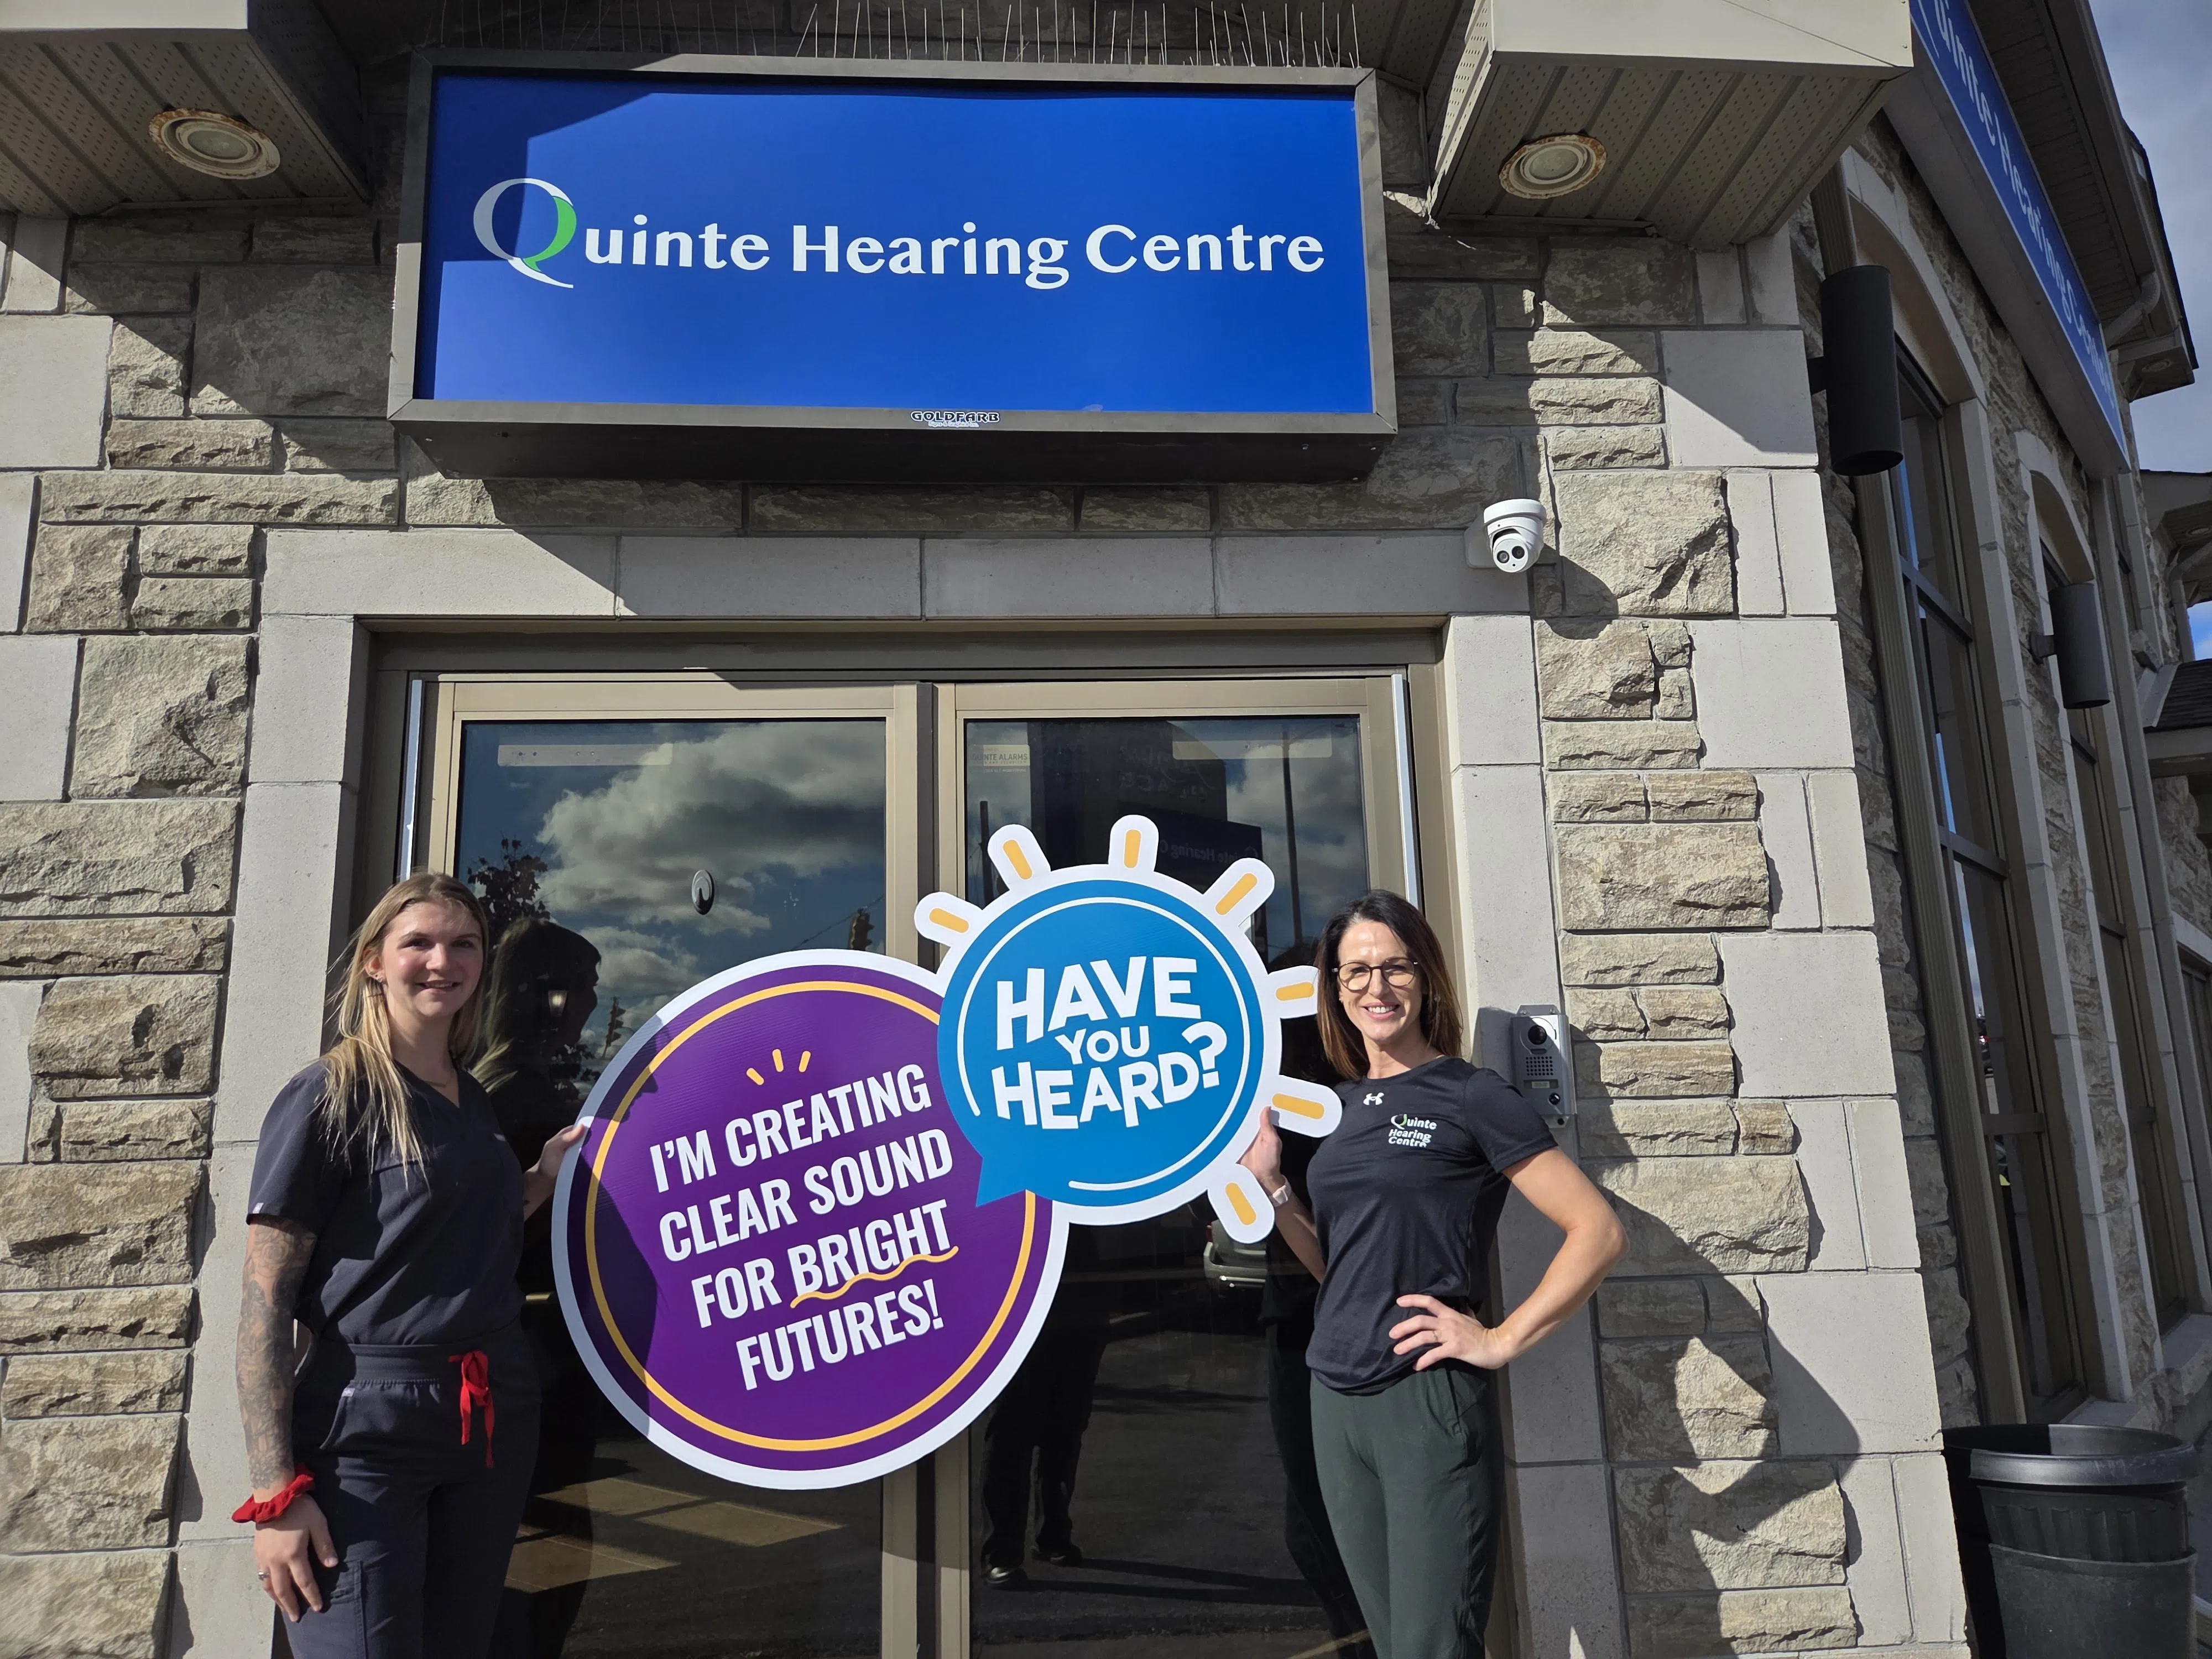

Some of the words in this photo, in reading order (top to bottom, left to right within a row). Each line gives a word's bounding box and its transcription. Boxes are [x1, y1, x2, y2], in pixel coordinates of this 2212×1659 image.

[1918, 0, 1995, 146] uinte
[1994, 112, 2066, 324] Hearing
[473, 178, 770, 289] Quinte
[793, 222, 1070, 290] Hearing
[1086, 225, 1325, 273] Centre
[911, 411, 1000, 423] GOLDFARB
[997, 956, 1201, 1051] HAVE
[1055, 1025, 1150, 1065] YOU
[649, 1129, 717, 1193] I'M
[725, 1064, 932, 1167] CREATING
[991, 1021, 1227, 1129] HEARD?
[1390, 1113, 1437, 1130] Quinte
[1388, 1136, 1427, 1147] Centre
[1389, 1129, 1432, 1144] Hearing
[659, 1178, 797, 1262] CLEAR
[804, 1129, 953, 1215] SOUND
[691, 1258, 782, 1328] FOR
[787, 1199, 951, 1297] BRIGHT
[736, 1279, 944, 1391] FUTURES!
